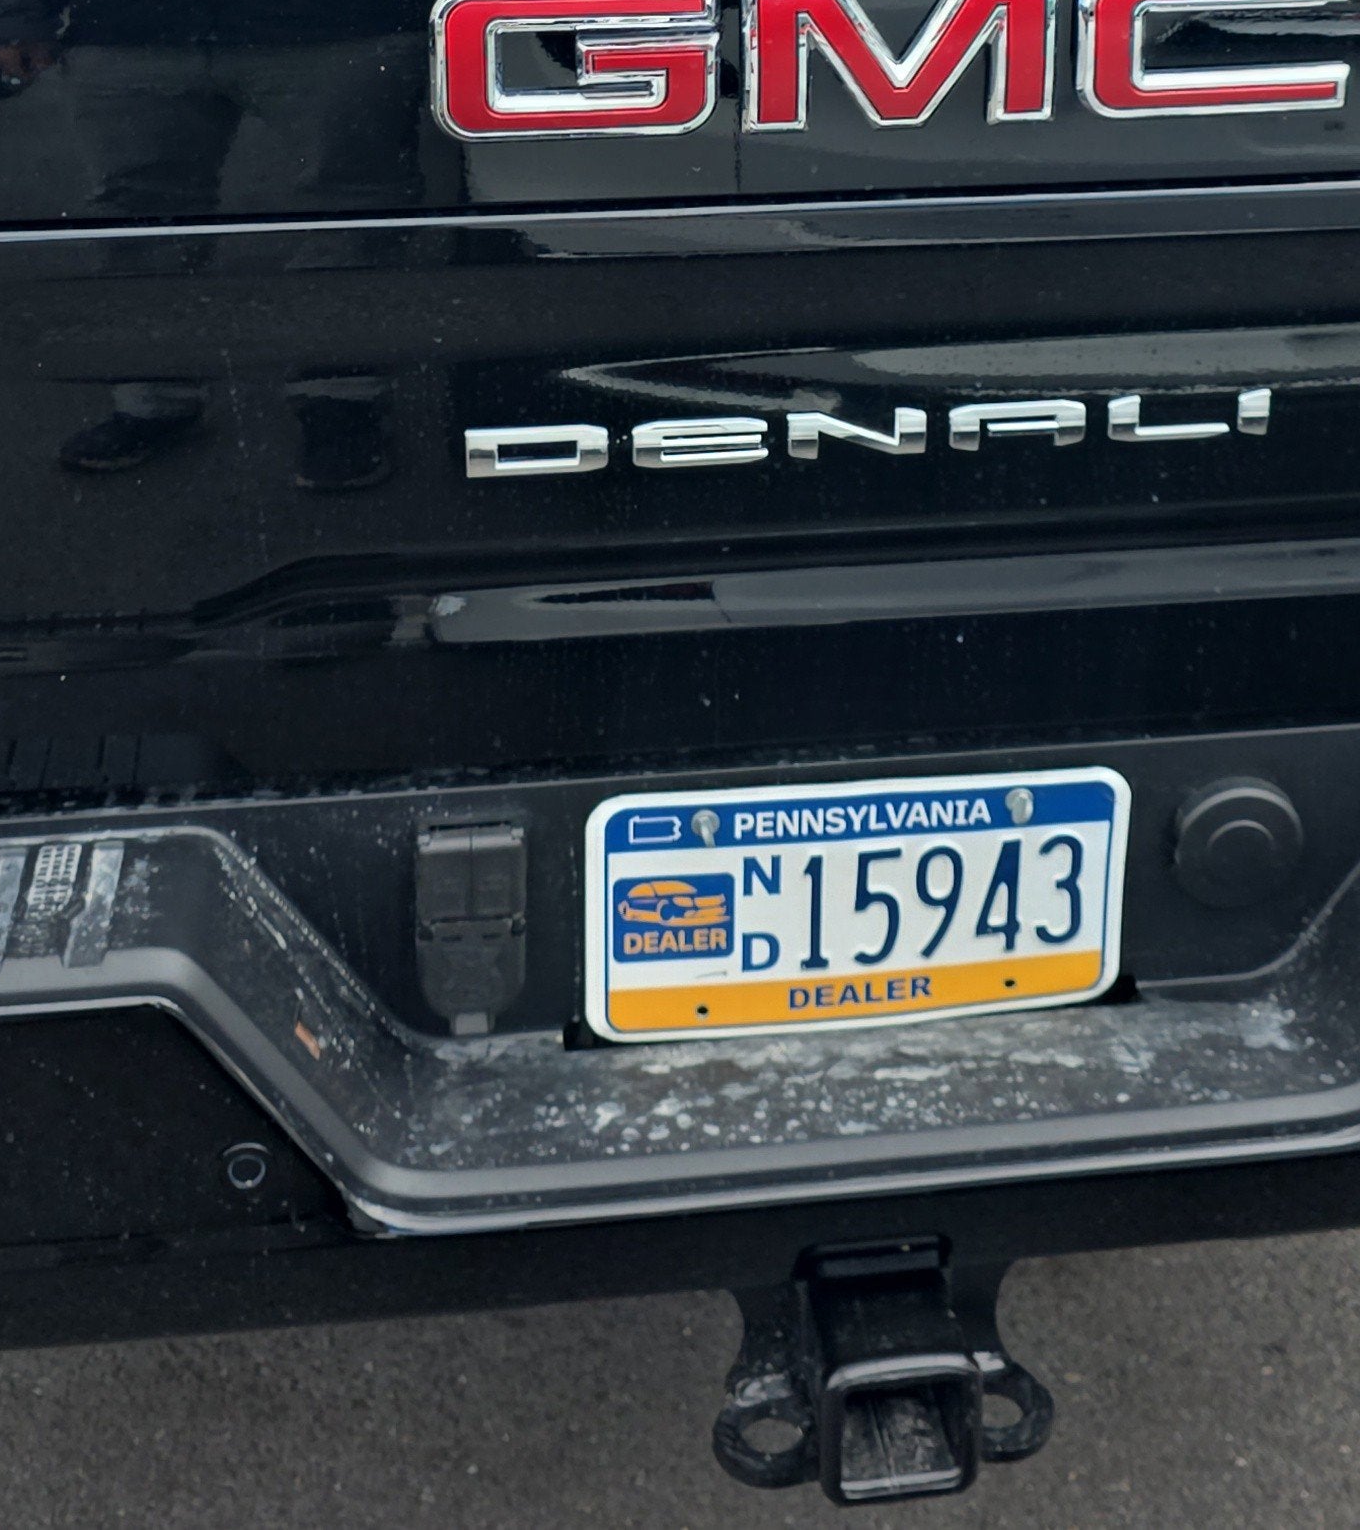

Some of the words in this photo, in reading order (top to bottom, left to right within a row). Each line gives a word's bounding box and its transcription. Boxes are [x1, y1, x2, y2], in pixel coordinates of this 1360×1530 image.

[463, 387, 1273, 480] DENALI
[732, 797, 993, 840] PENNSYLVANIA
[797, 831, 1084, 971] 15943
[622, 927, 728, 955] DEALER
[787, 974, 933, 1012] DEALER
